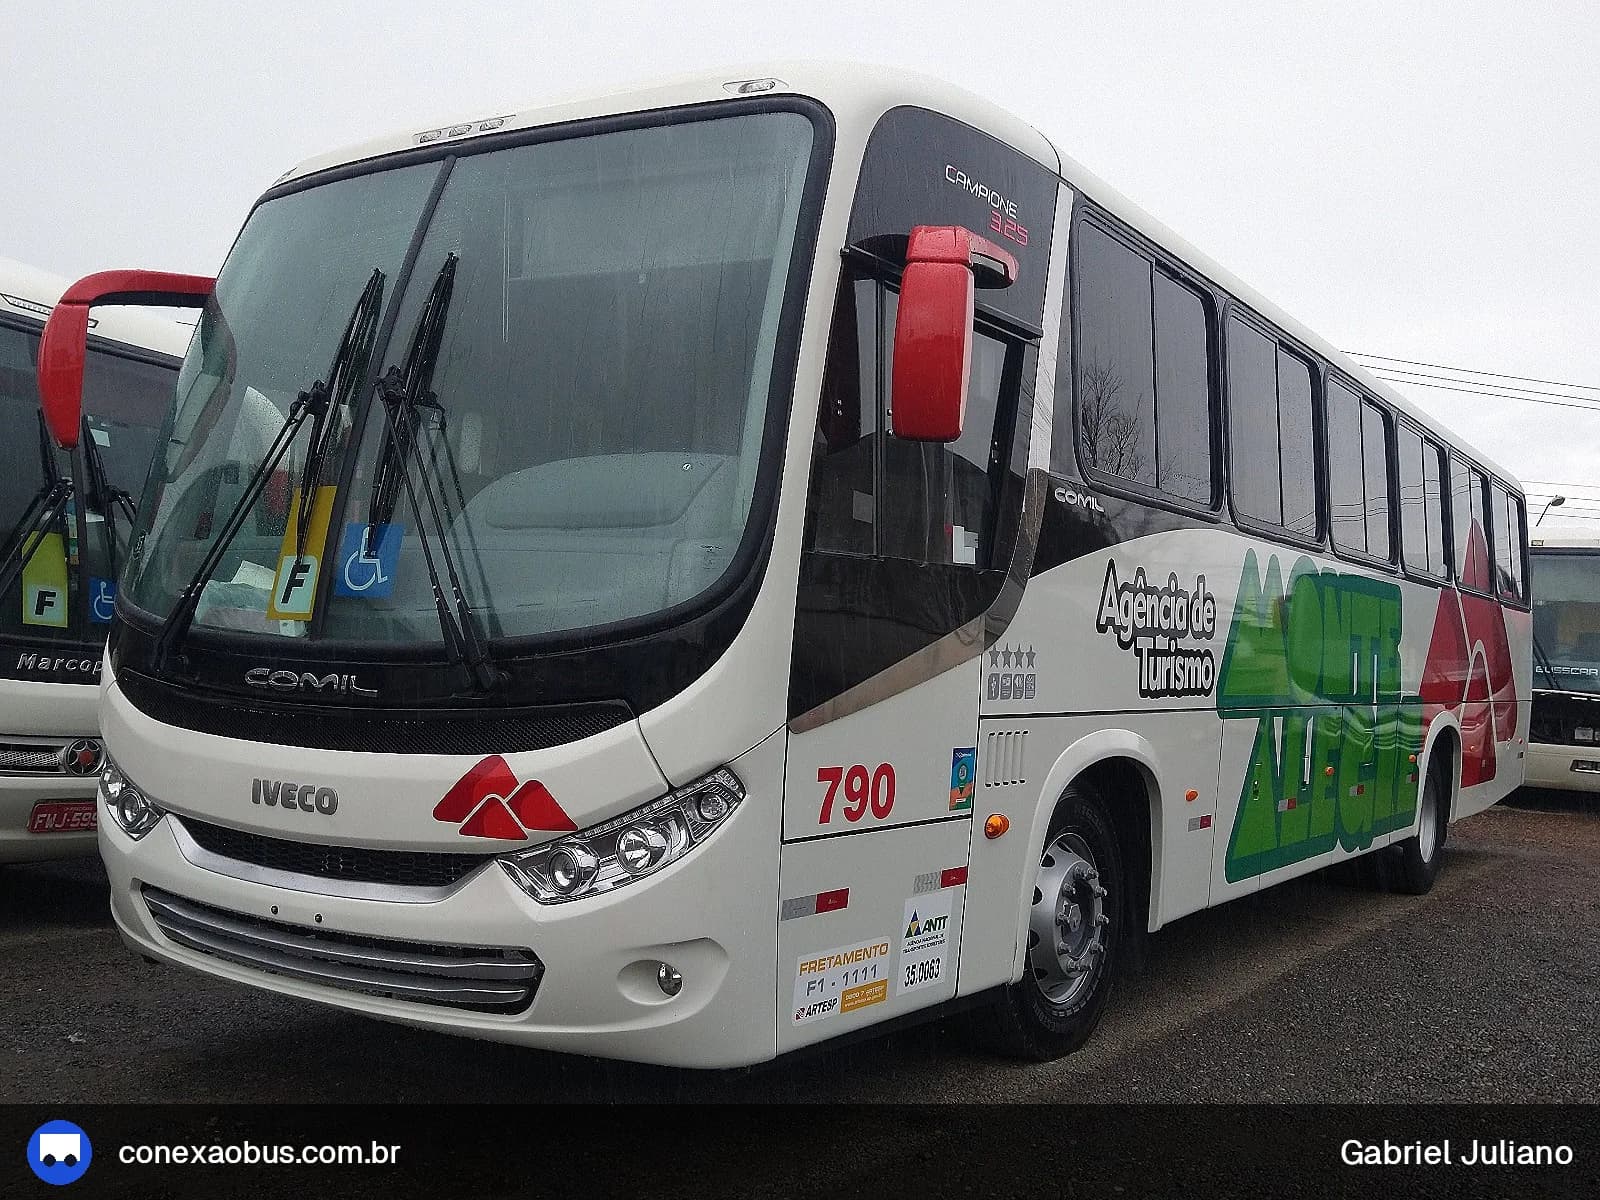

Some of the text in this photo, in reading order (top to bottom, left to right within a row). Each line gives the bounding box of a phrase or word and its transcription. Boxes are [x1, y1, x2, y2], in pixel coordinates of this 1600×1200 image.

[945, 164, 1018, 220] CAMPIONE
[990, 210, 1028, 247] 3.25
[1055, 487, 1105, 513] COMIL
[281, 563, 311, 604] F
[35, 590, 57, 616] F
[1097, 559, 1216, 648] Agência de
[1217, 548, 1402, 717] MONTE
[245, 667, 378, 698] COMIL
[1135, 636, 1215, 698] Turismo
[251, 778, 339, 816] IVECO
[817, 762, 896, 825] 790
[1225, 697, 1423, 884] ALEGRE
[922, 915, 948, 934] ANTT
[799, 942, 889, 976] FRETAMENTO
[806, 977, 825, 997] F1
[842, 963, 878, 987] 1111
[804, 997, 838, 1018] ARTESP
